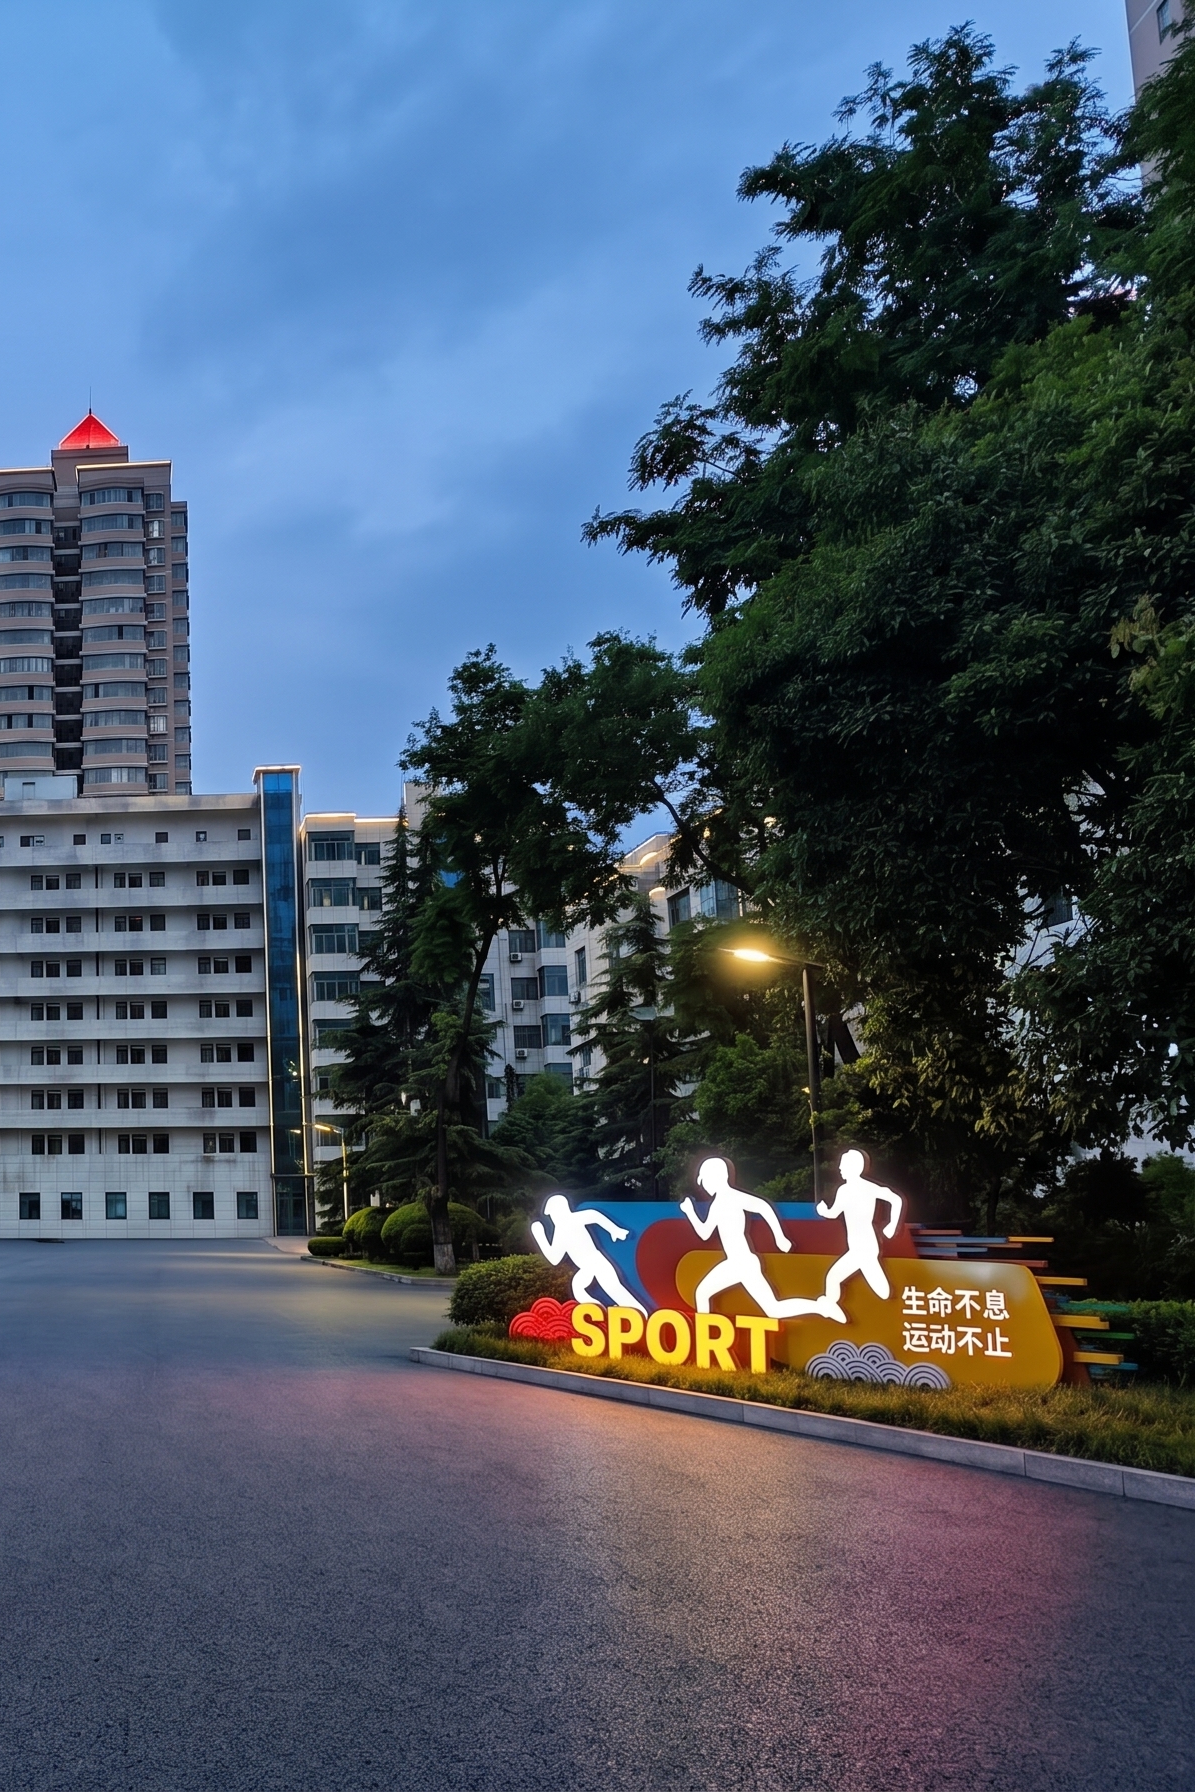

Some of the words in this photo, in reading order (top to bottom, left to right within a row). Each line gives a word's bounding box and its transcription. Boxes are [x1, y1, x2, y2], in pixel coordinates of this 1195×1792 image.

[902, 1286, 1010, 1320] 生命不息
[571, 1303, 779, 1373] SPORT
[902, 1322, 1013, 1358] 运动不止
